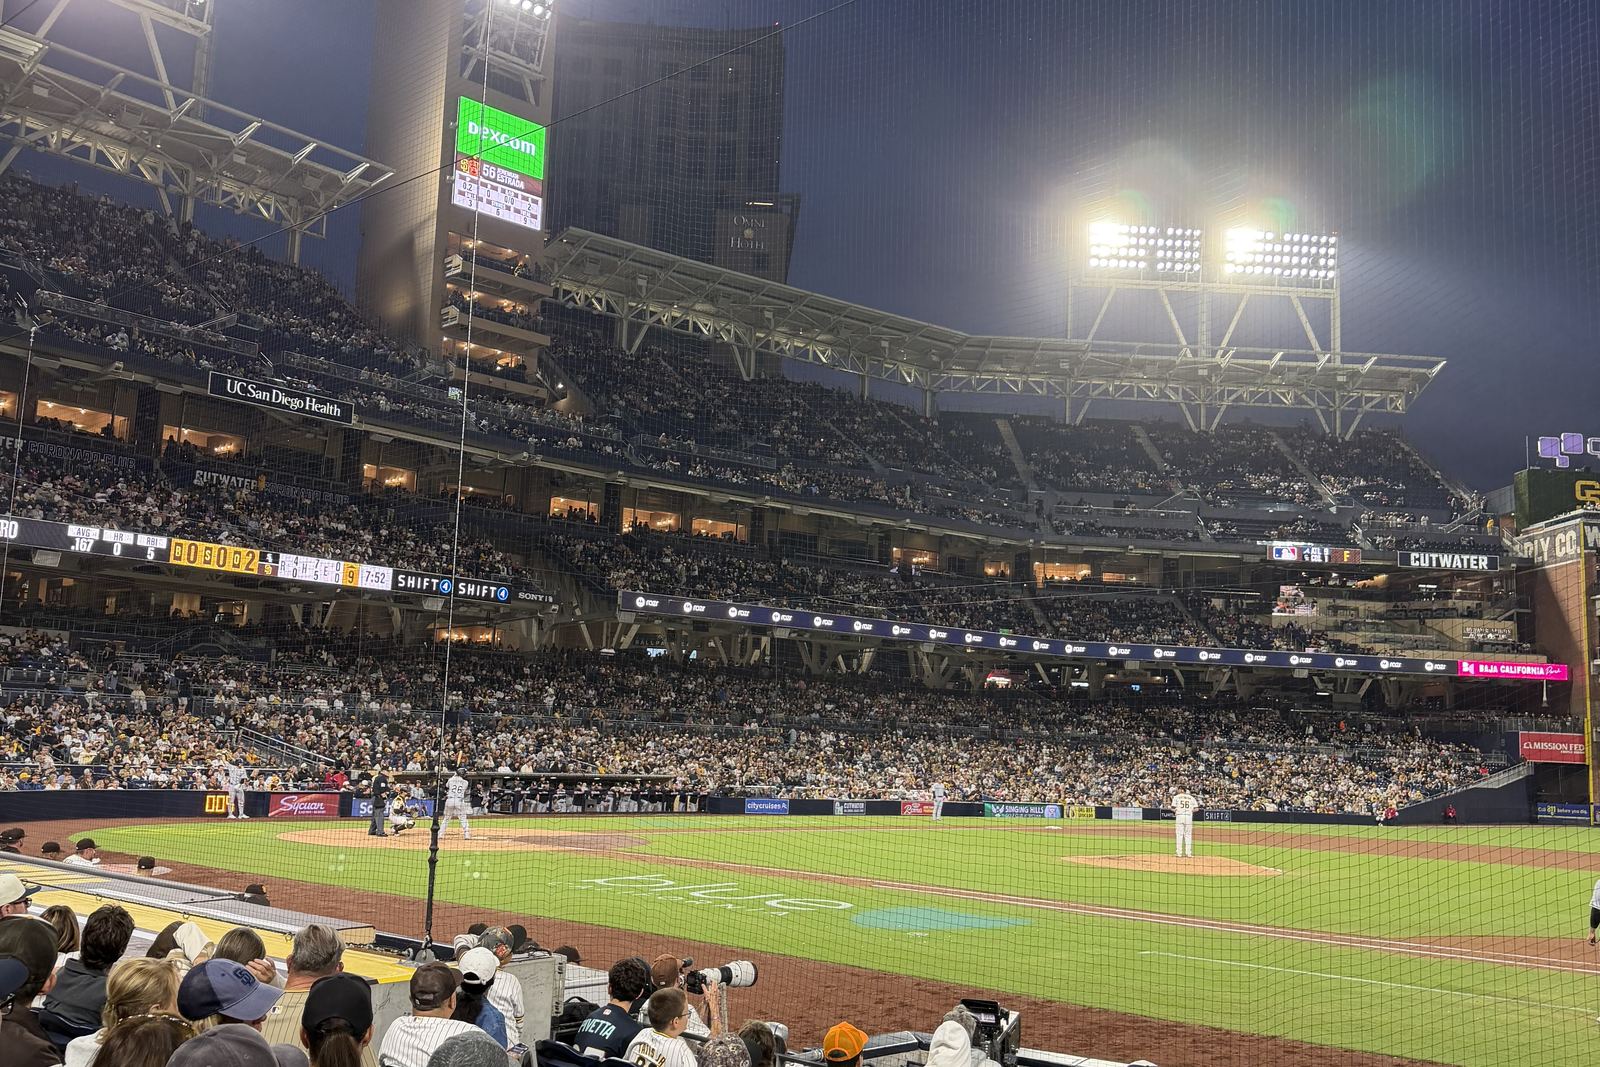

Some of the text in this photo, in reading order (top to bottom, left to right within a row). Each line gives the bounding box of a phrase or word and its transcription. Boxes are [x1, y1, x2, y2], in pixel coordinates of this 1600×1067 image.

[483, 164, 497, 179] 56
[497, 173, 525, 190] ESTRADA
[227, 379, 341, 416] UC San Diego Health
[28, 441, 101, 460] CORONADO
[103, 453, 136, 469] CLUB
[76, 527, 91, 538] AVG
[113, 533, 124, 541] HR
[71, 538, 95, 553] .167
[146, 537, 158, 547] RBI
[1555, 530, 1581, 558] CO.
[113, 543, 121, 556] 0
[147, 547, 155, 560] 5
[1343, 550, 1350, 562] F
[187, 543, 199, 565] 0
[216, 546, 228, 568] 0
[245, 550, 256, 572] 2
[293, 556, 341, 572] 4 7 0
[1410, 552, 1488, 570] CUTWATER
[280, 561, 286, 571] R
[301, 566, 308, 575] H
[292, 568, 341, 584] 0 5 0
[347, 571, 355, 585] 9
[365, 570, 387, 585] 7:52
[518, 592, 544, 602] SONY
[1479, 664, 1499, 673] BAJA
[1500, 665, 1545, 675] CALIFORNIA
[1533, 741, 1568, 751] MISSION
[451, 784, 463, 794] 26
[280, 795, 325, 815] Sycuan
[1005, 805, 1029, 813] SINGING
[1029, 806, 1044, 814] HILLS
[1180, 800, 1190, 809] 56
[580, 874, 854, 911] blue
